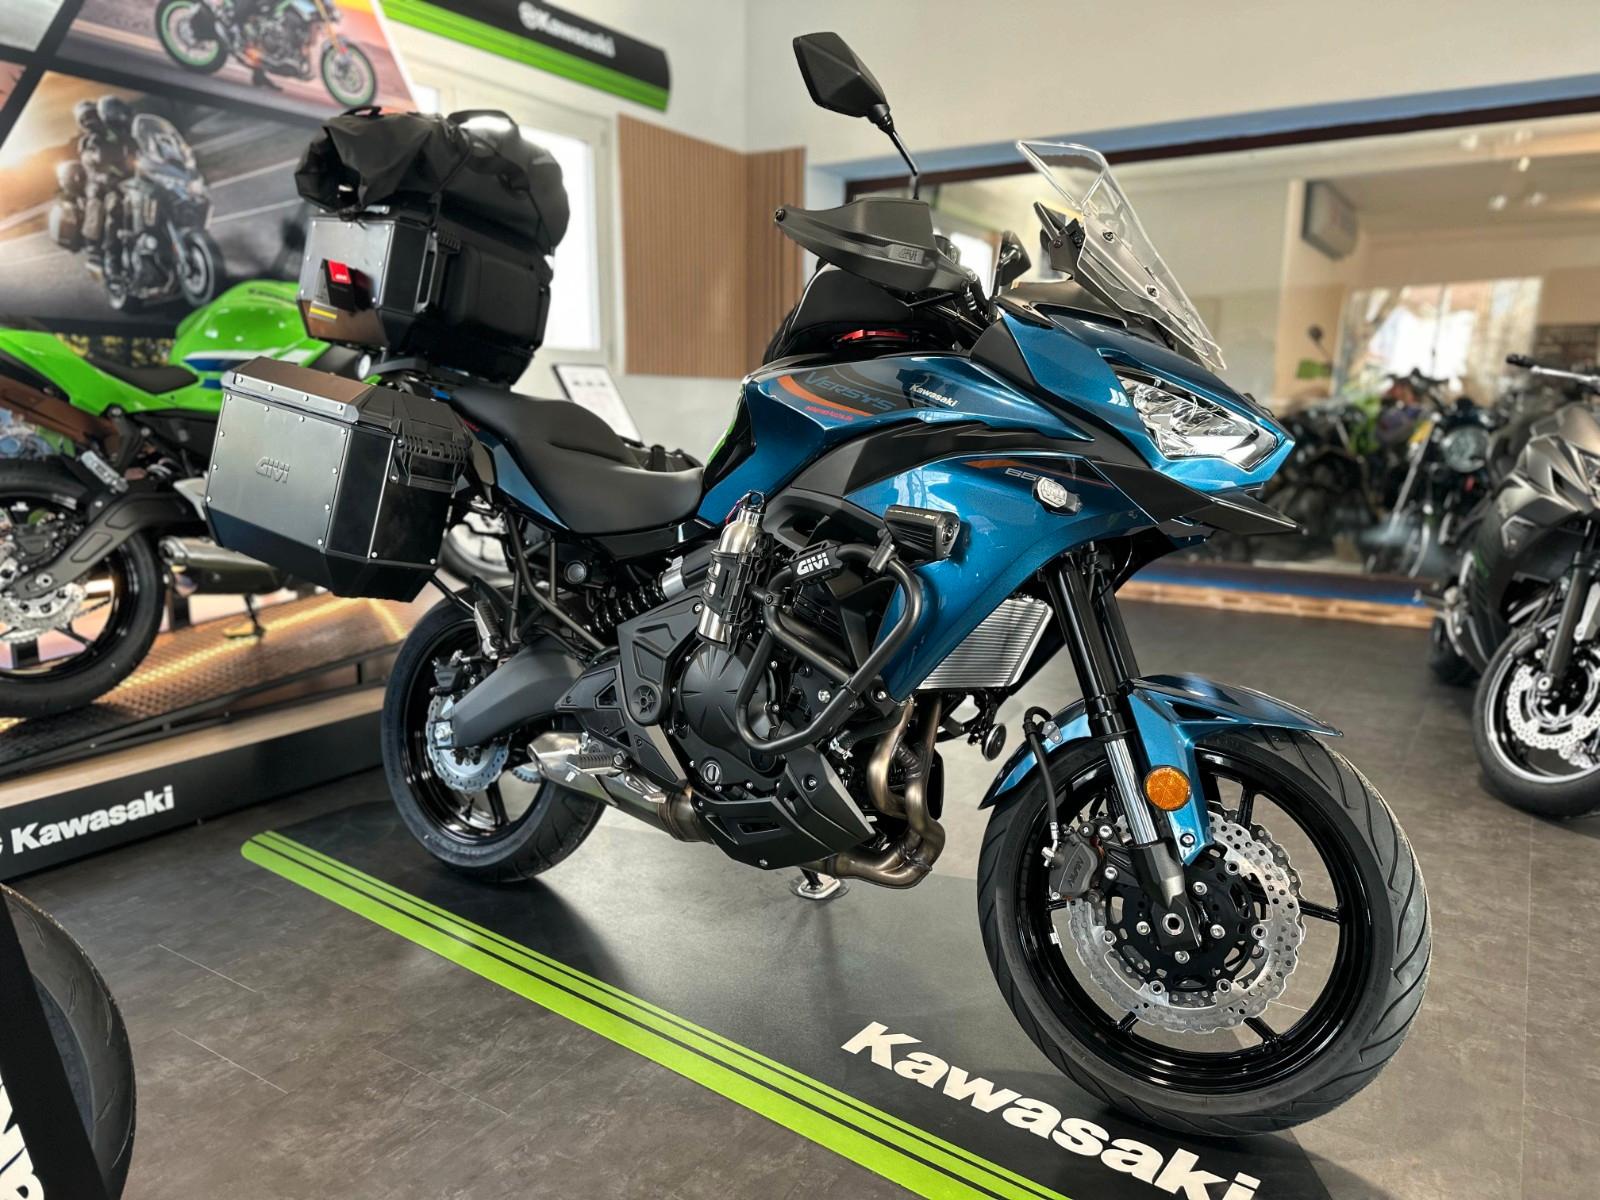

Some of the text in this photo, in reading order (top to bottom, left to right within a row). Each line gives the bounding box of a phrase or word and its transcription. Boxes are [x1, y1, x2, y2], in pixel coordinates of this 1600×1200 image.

[909, 383, 959, 408] Kawasaki
[256, 456, 290, 484] GIVI
[796, 552, 830, 576] GIVI
[10, 785, 175, 854] Kawasaki
[840, 1020, 1261, 1200] Kawasaki
